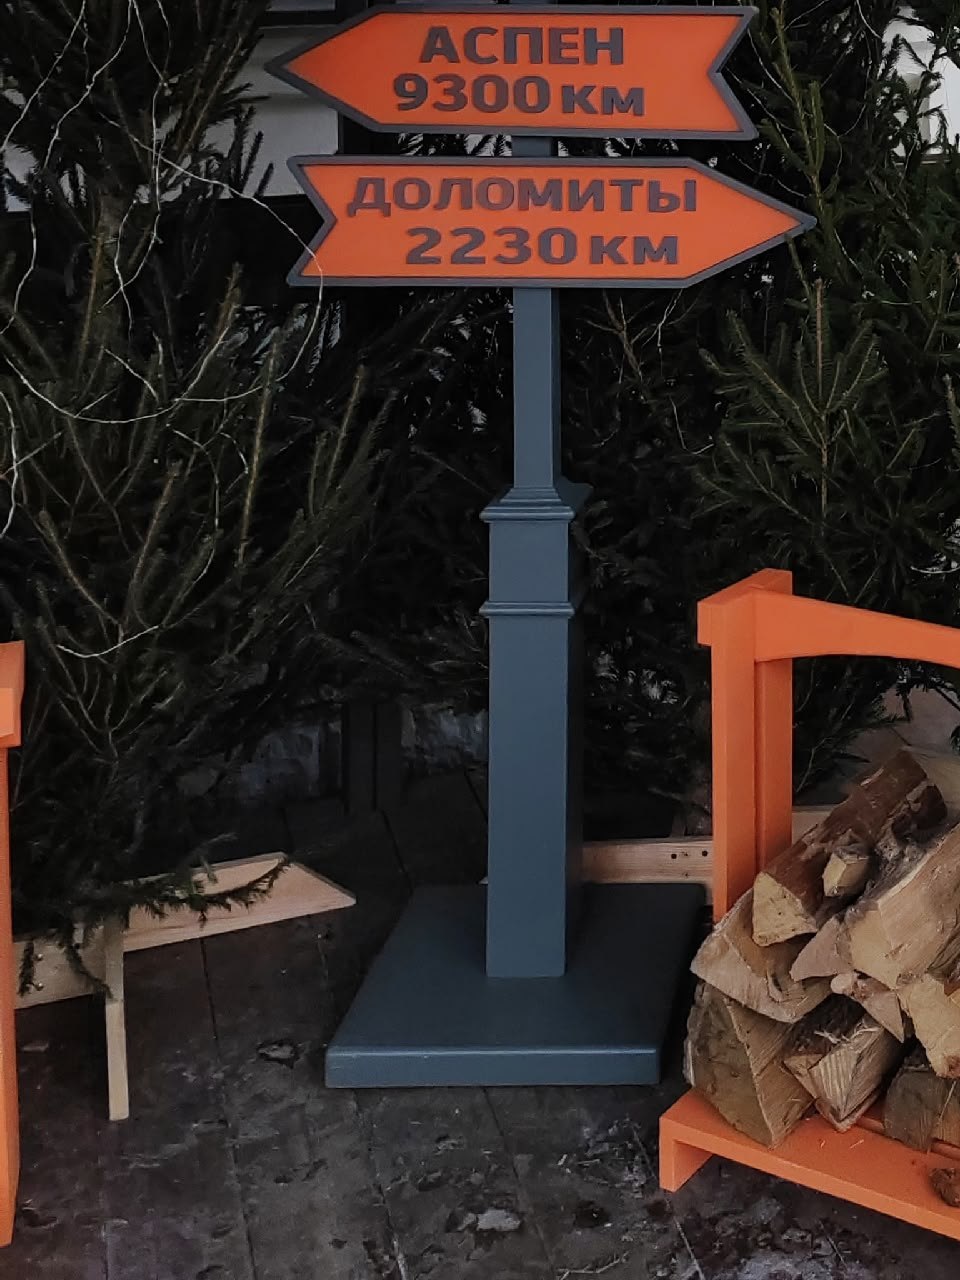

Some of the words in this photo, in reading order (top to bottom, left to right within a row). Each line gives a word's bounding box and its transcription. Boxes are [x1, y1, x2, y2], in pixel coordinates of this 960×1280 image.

[420, 27, 623, 65] АСПЕН
[393, 74, 550, 113] 9300
[347, 178, 696, 217] ДОЛОМИТЫ
[406, 227, 577, 264] 2230
